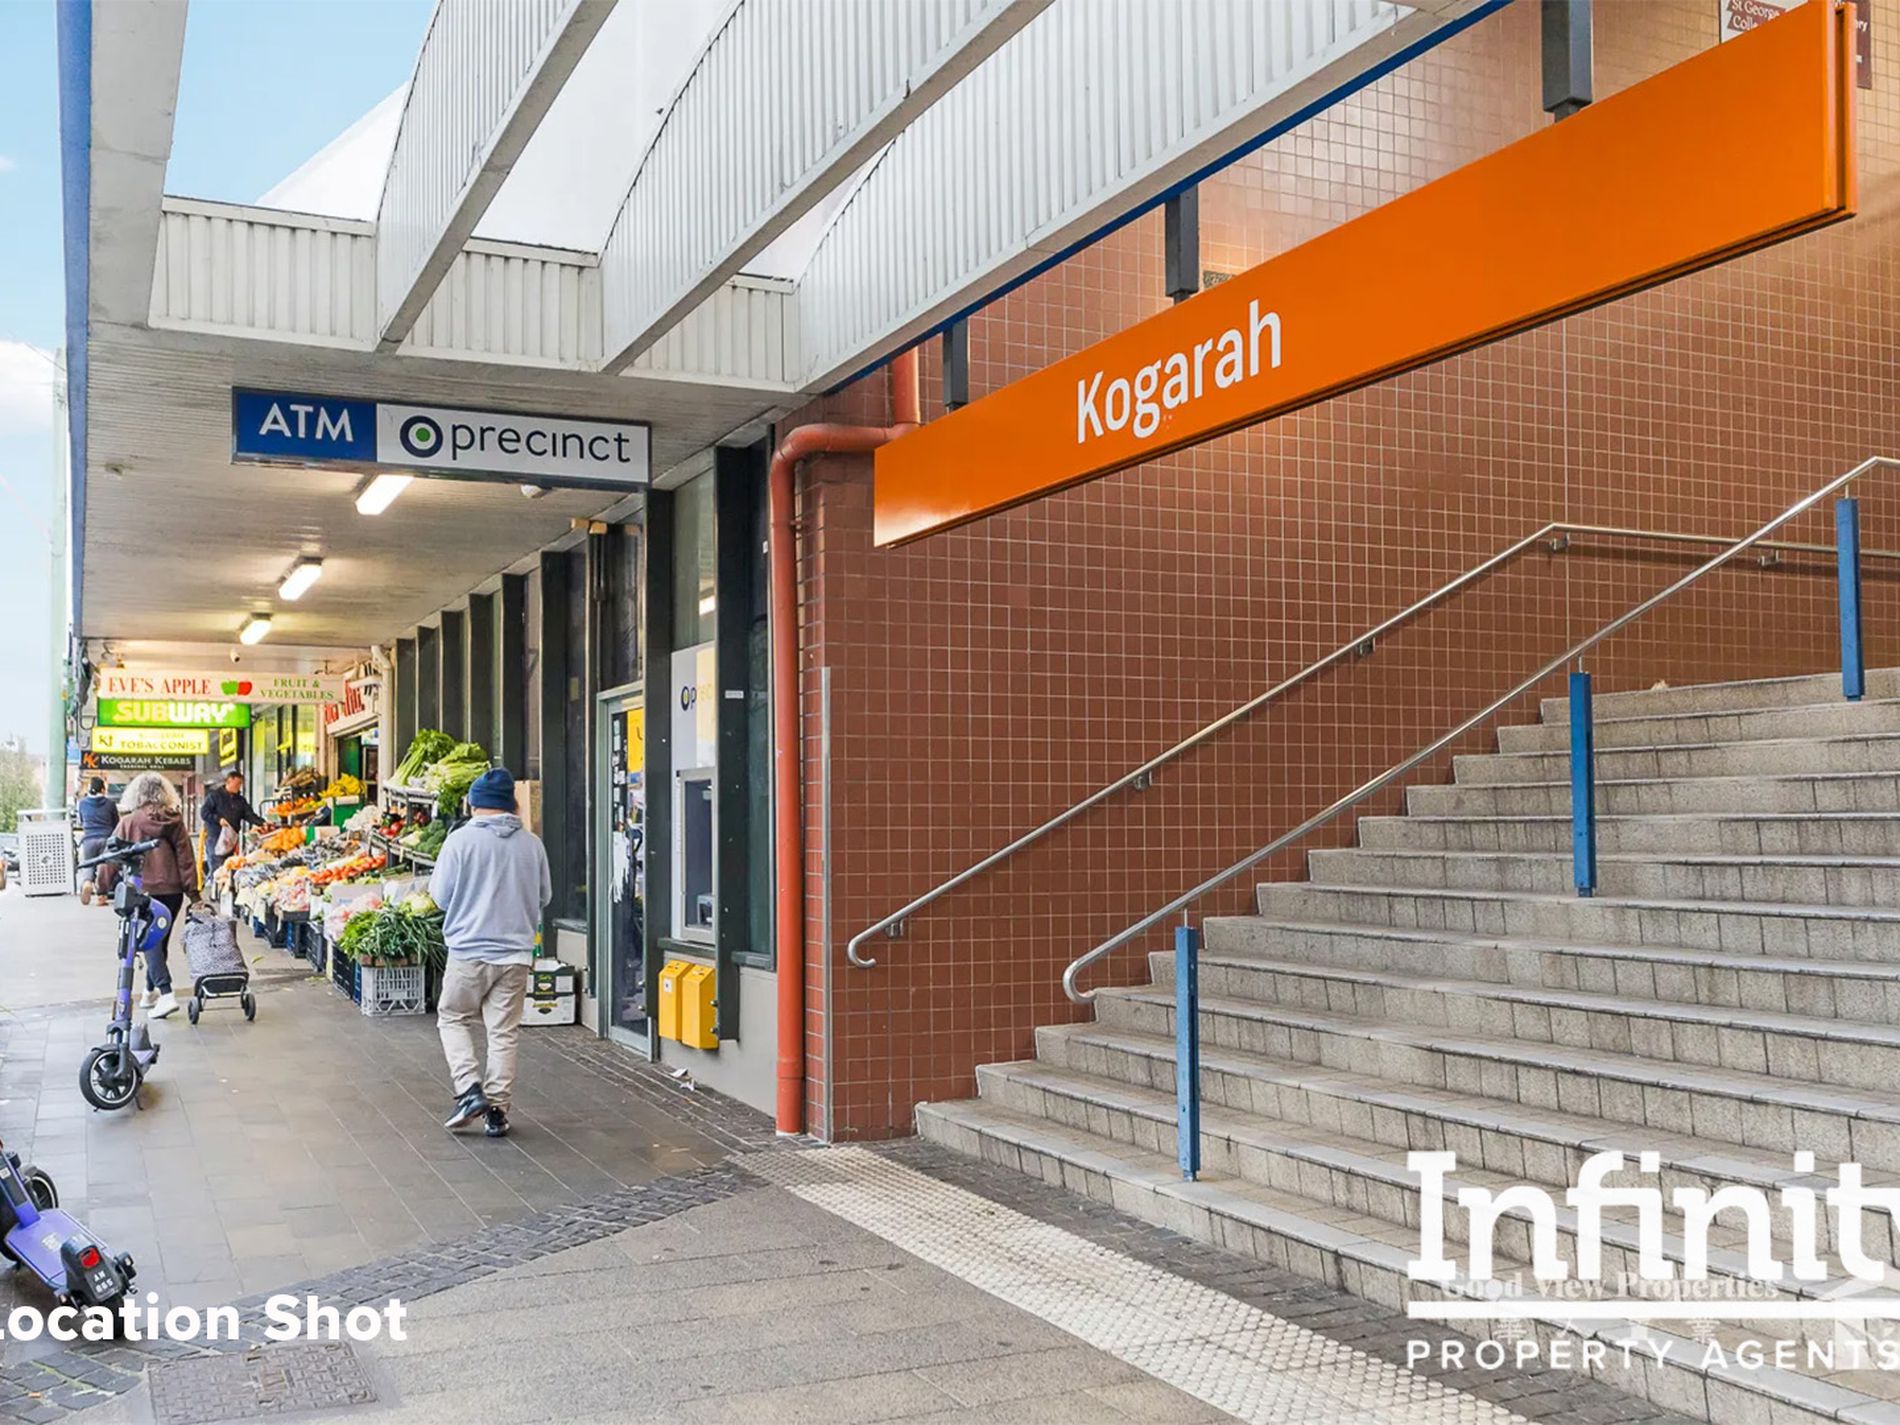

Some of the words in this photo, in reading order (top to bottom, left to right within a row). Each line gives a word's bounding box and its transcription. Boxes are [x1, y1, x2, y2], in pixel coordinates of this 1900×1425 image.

[1078, 299, 1282, 445] Kogarah
[258, 402, 354, 442] ATM
[451, 422, 631, 464] precinct
[108, 677, 154, 694] EVE'S
[160, 677, 212, 695] APPLE
[274, 678, 308, 688] FRUIT
[312, 678, 321, 688] &
[260, 688, 335, 700] VEGETABLES
[112, 700, 236, 724] SUBWAY
[120, 740, 203, 750] TOBACCONIST
